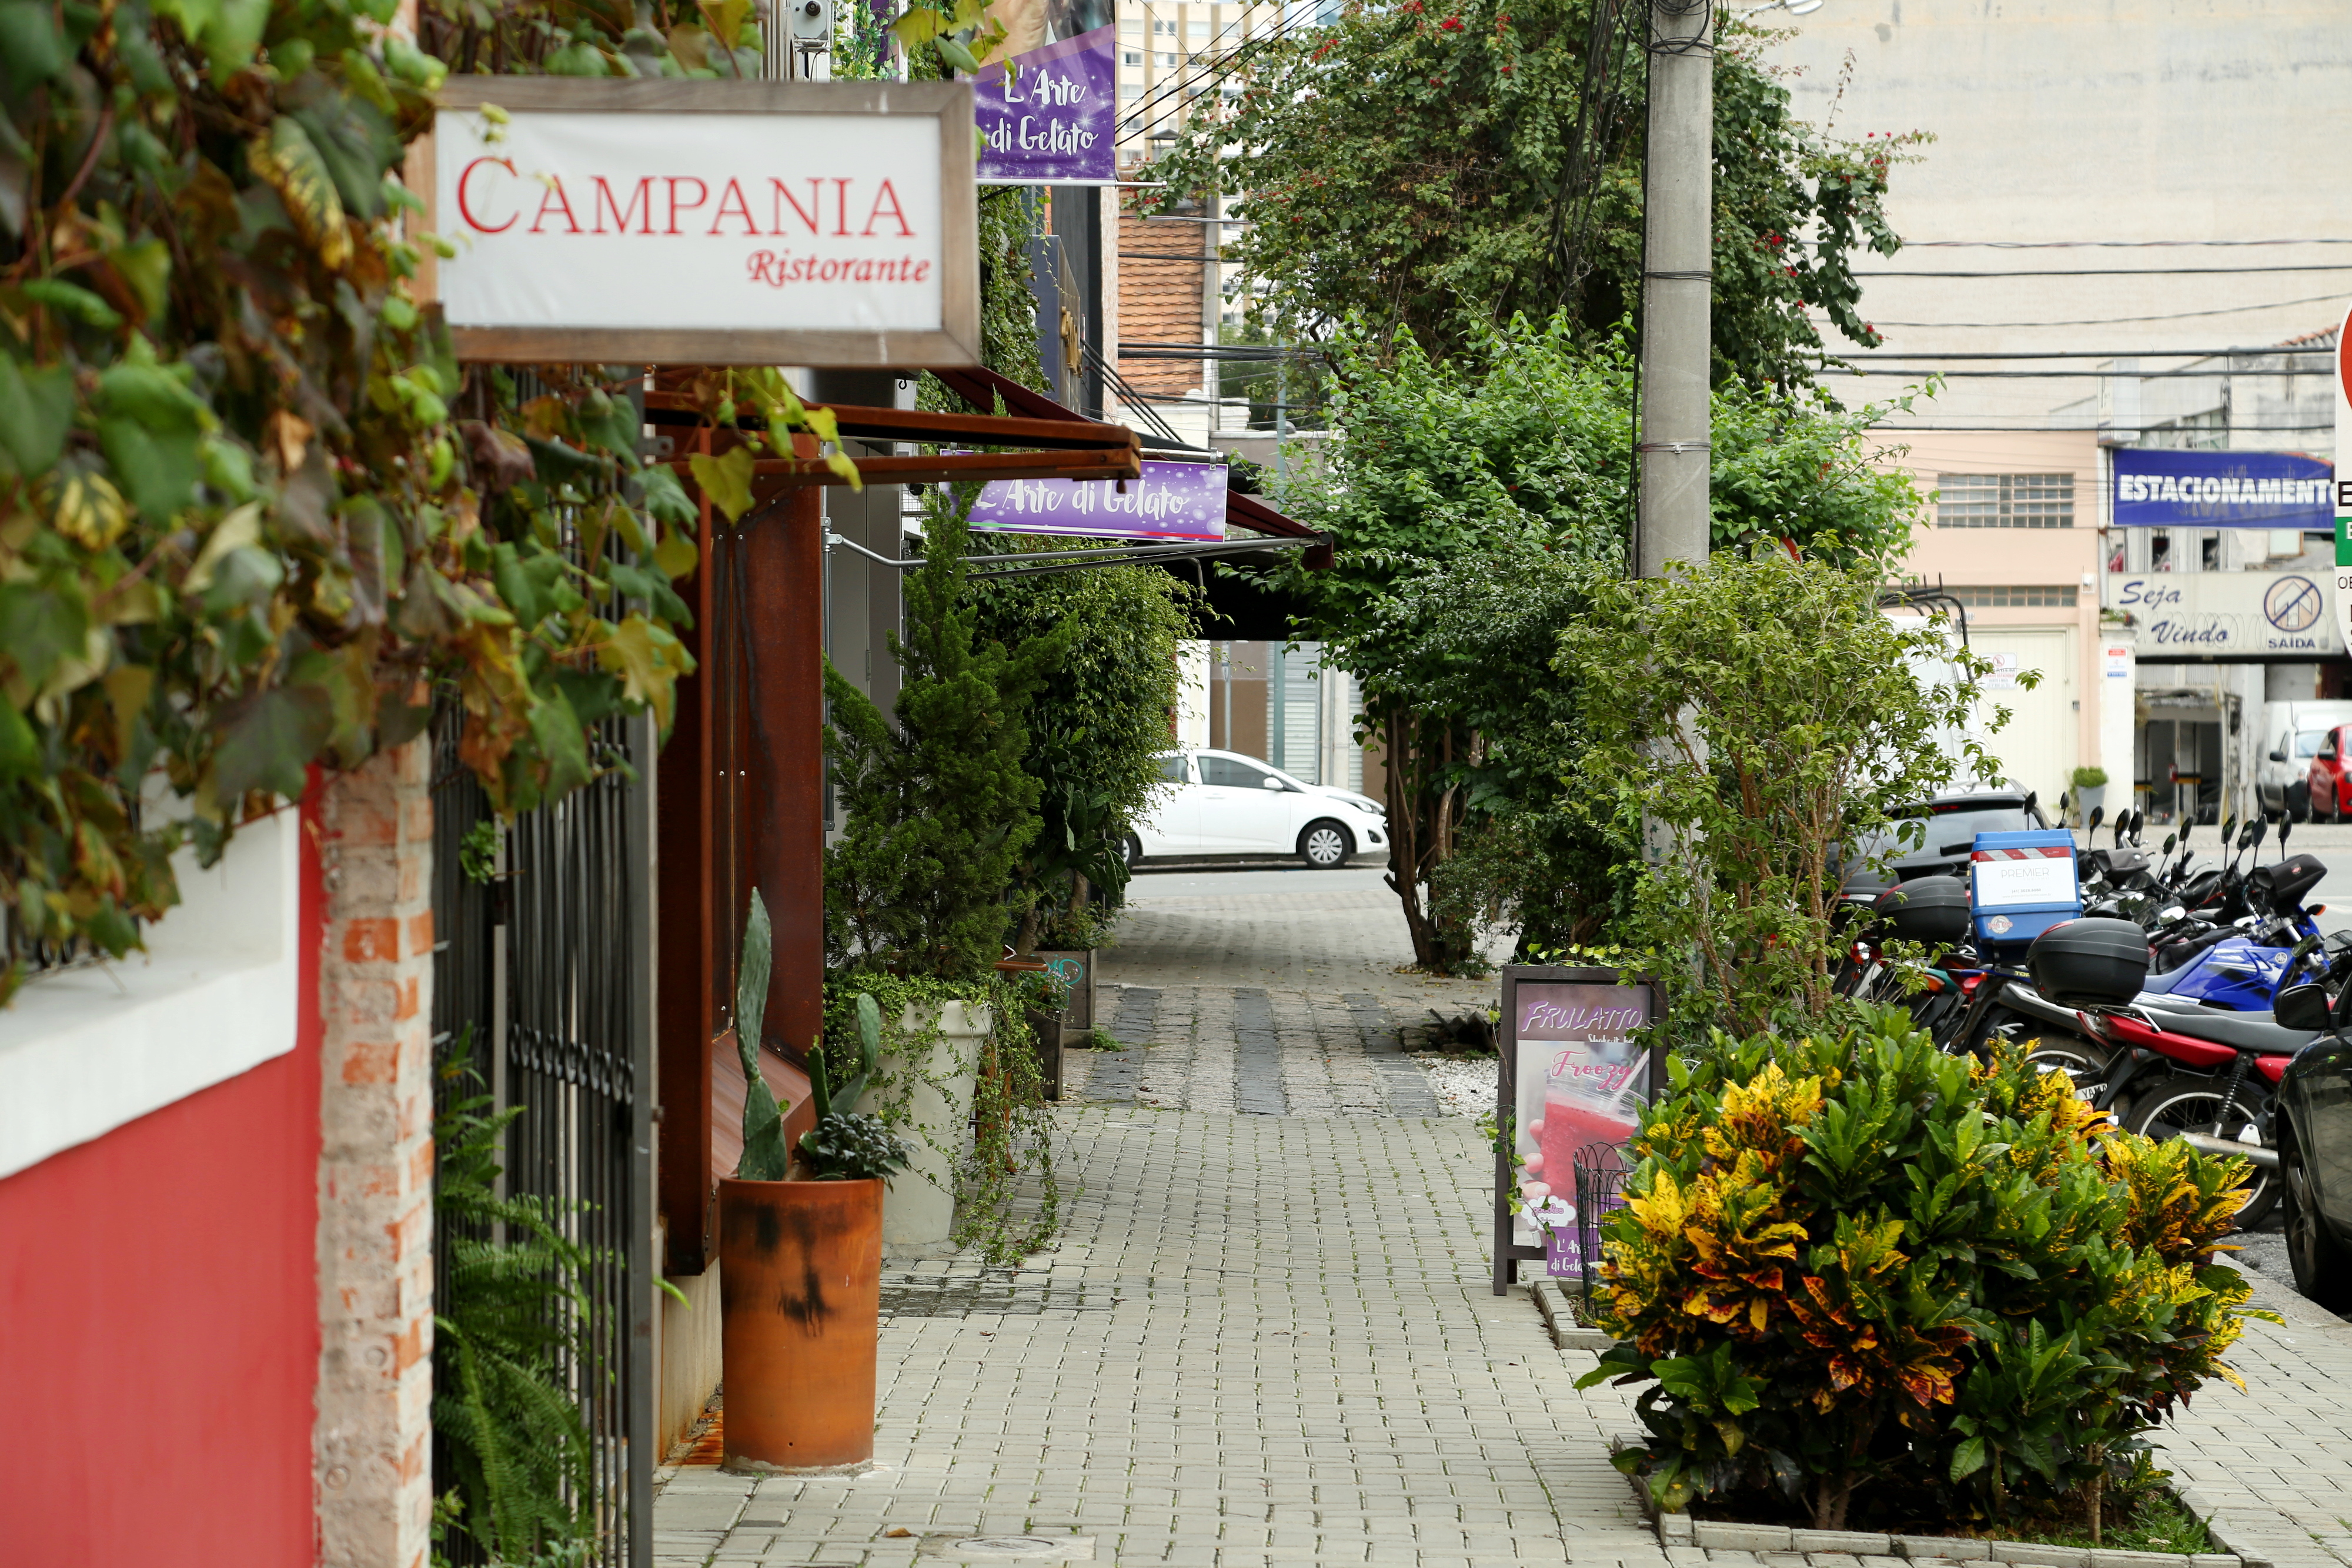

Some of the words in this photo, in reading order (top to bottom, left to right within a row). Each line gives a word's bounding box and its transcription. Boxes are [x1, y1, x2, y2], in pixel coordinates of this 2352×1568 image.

[991, 118, 1011, 153] di
[1020, 115, 1099, 156] Gelato
[457, 156, 916, 236] CAMPANIA
[747, 249, 931, 288] Ristorante
[1072, 480, 1095, 515] di
[1104, 479, 1190, 521] Gelato
[2120, 474, 2335, 504] ESTACIONAMENT
[2119, 580, 2183, 610] Seja
[2151, 620, 2229, 643] Vindo
[2001, 867, 2050, 878] PREMIER
[1522, 1001, 1643, 1032] FRULATTO
[1552, 1051, 1638, 1092] Froozy
[1551, 1258, 1560, 1272] di
